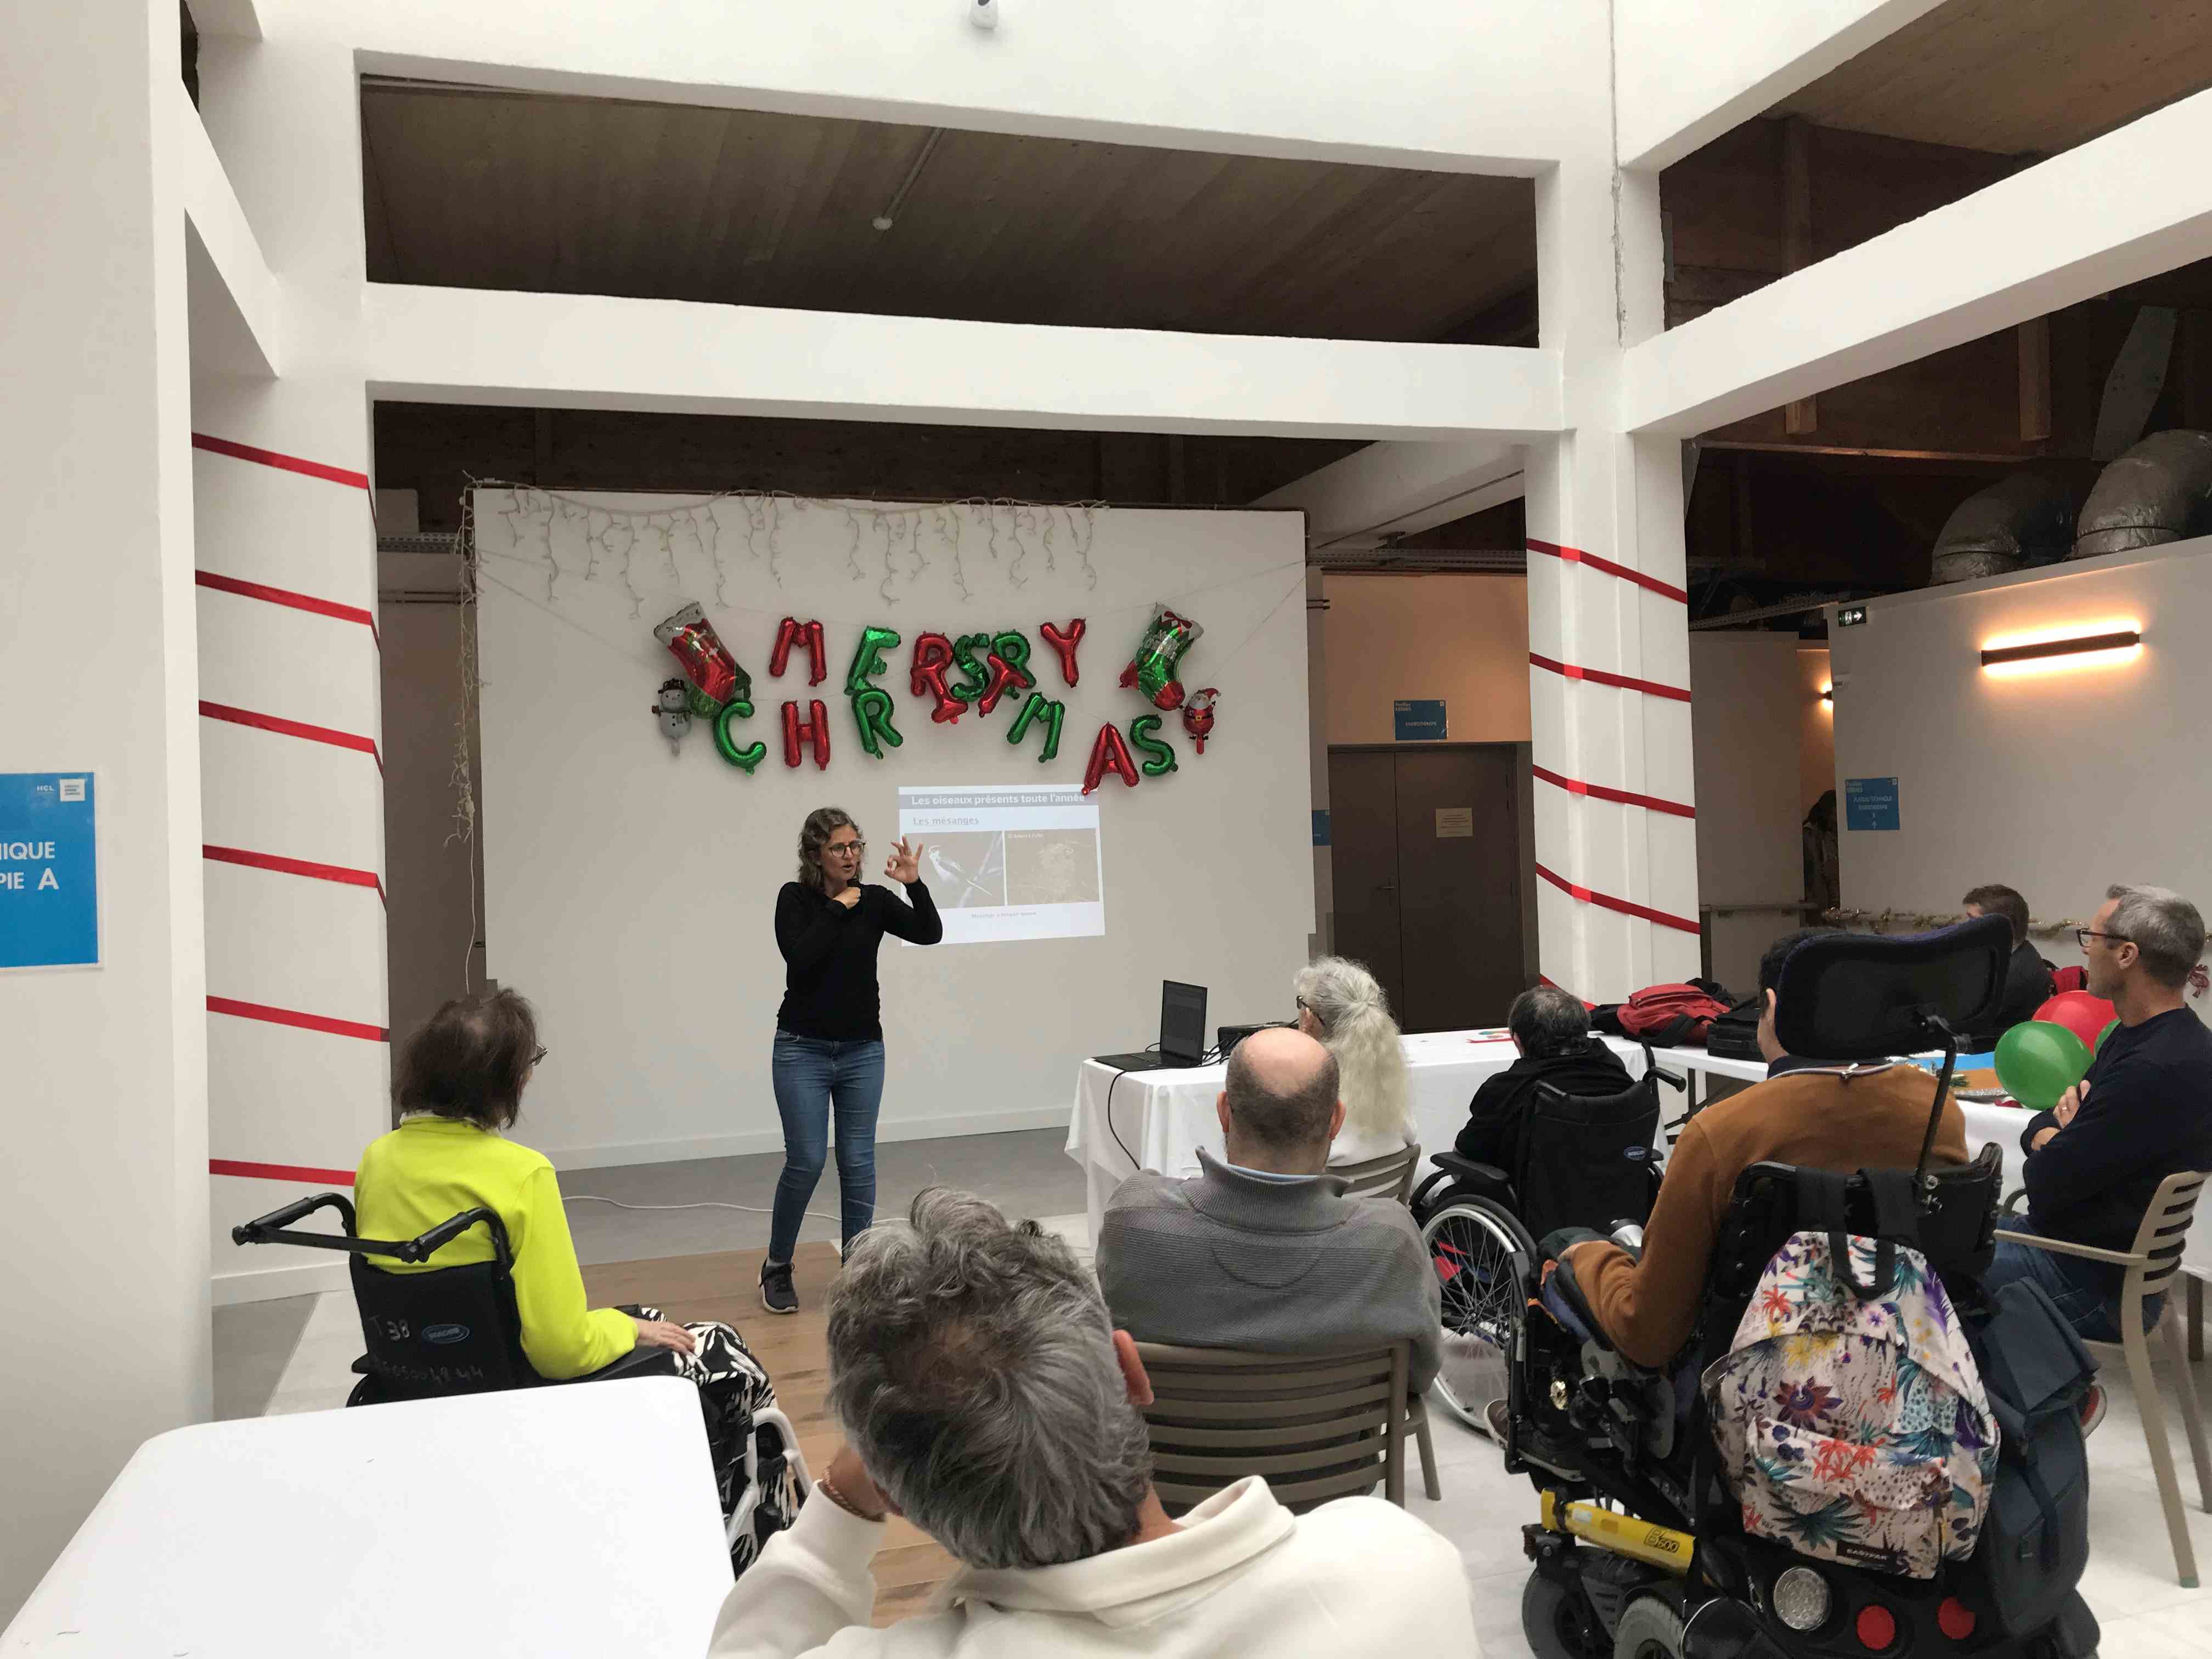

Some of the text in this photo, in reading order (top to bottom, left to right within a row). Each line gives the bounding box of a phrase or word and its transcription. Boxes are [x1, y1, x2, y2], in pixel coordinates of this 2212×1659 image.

[769, 616, 1086, 699] MERRY
[713, 633, 1178, 795] CHRISTMAS
[911, 793, 1085, 805] Les oiseaux présents toute l'année
[913, 816, 980, 826] Les mésanges
[0, 842, 55, 860] IQUE
[37, 867, 59, 890] A
